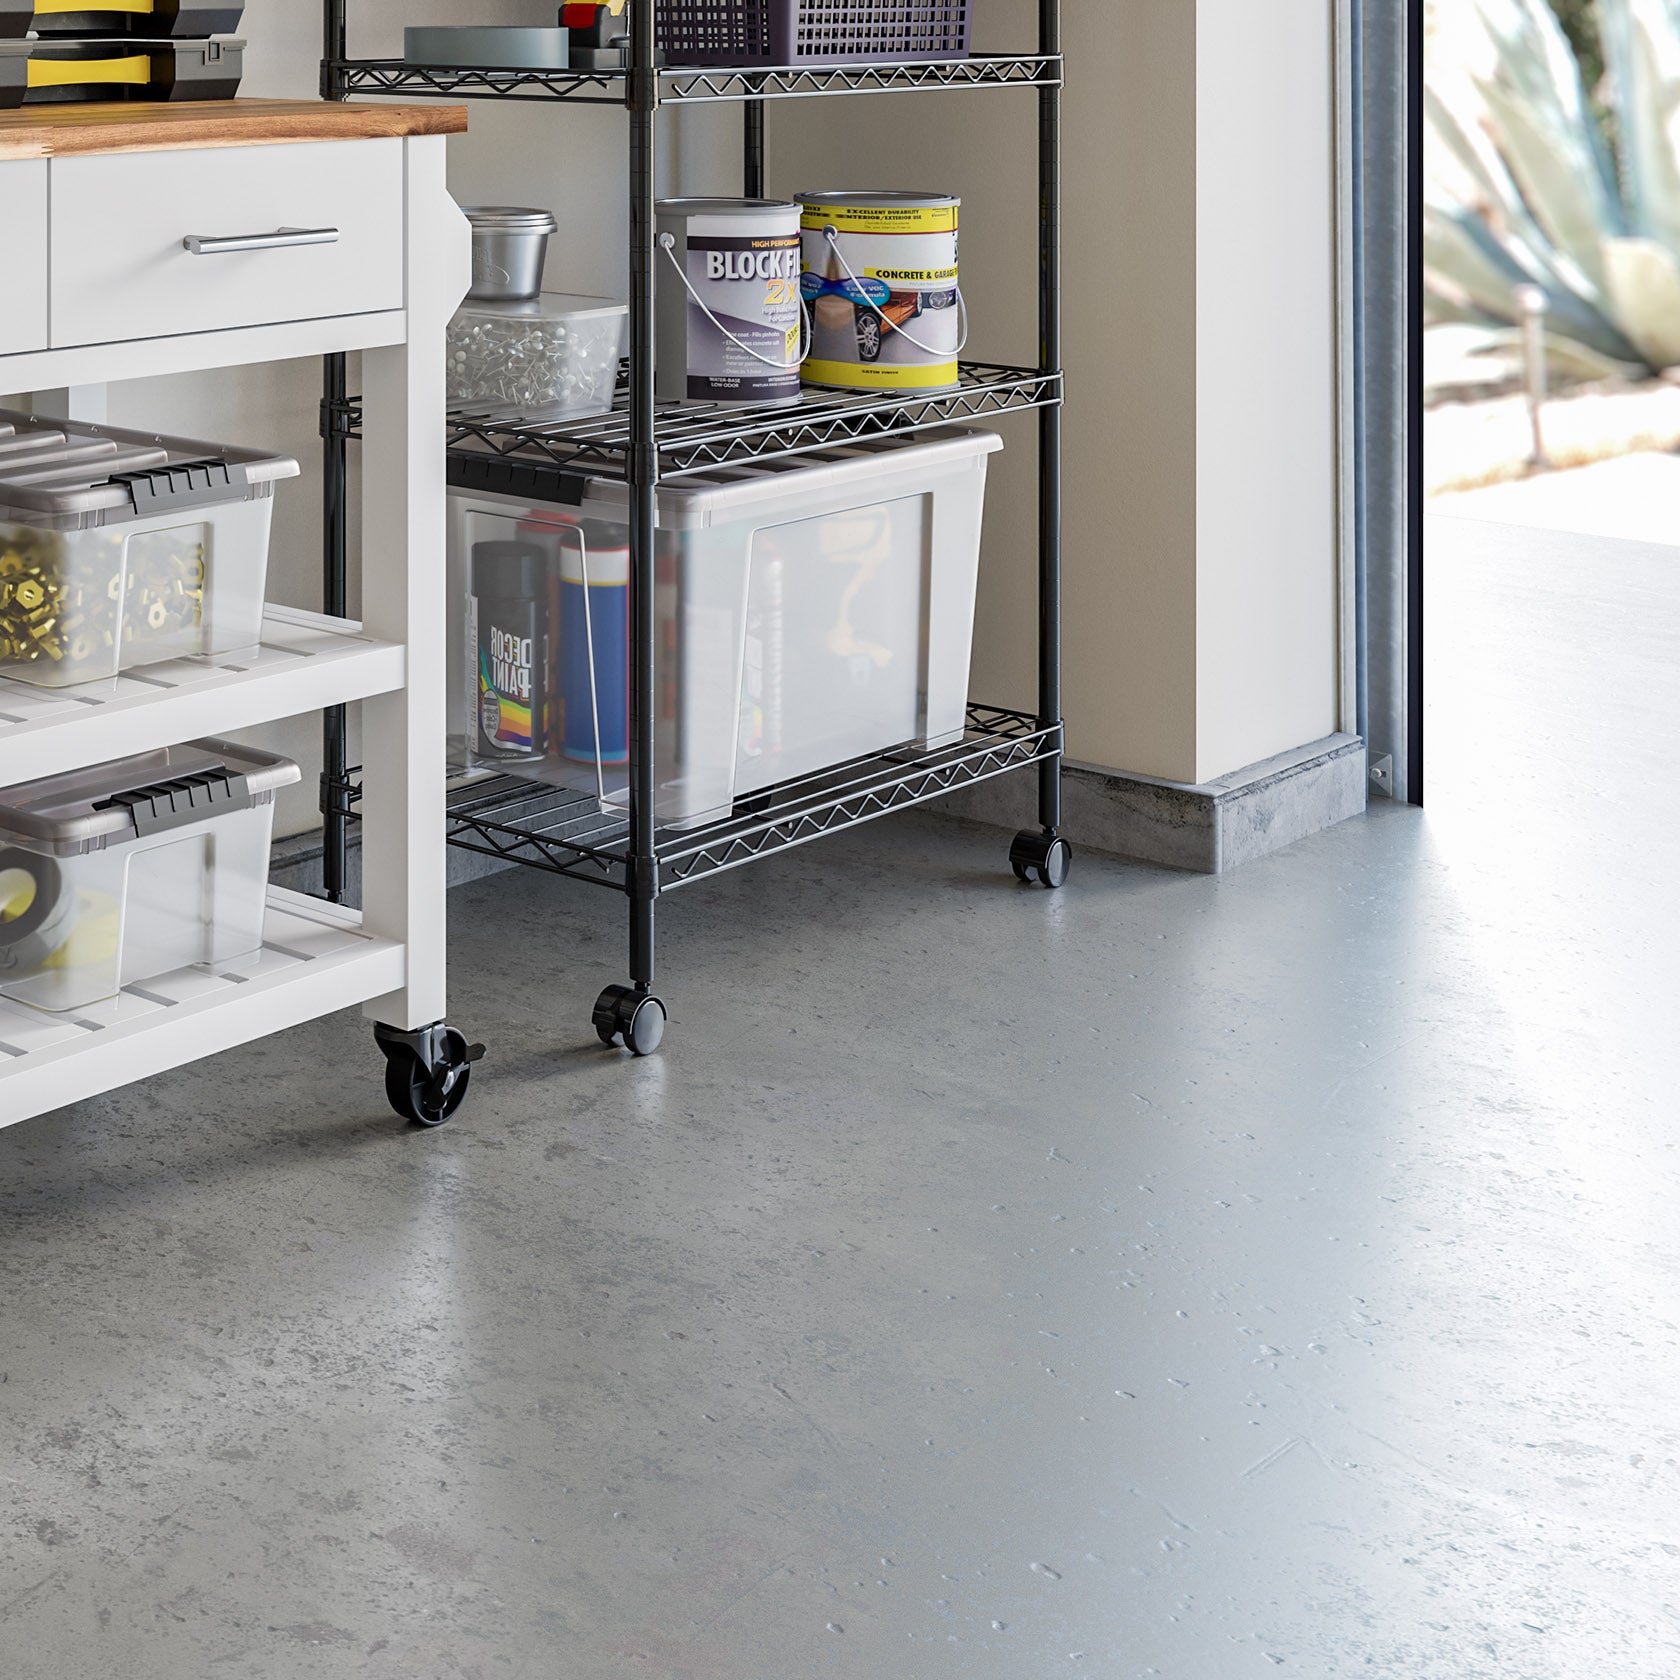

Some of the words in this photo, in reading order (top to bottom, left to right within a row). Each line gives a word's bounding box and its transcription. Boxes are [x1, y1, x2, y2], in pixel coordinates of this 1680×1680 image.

[751, 240, 770, 248] HIGH
[707, 250, 783, 280] BLOCK
[876, 270, 924, 279] CONCRETE
[926, 271, 932, 279] &
